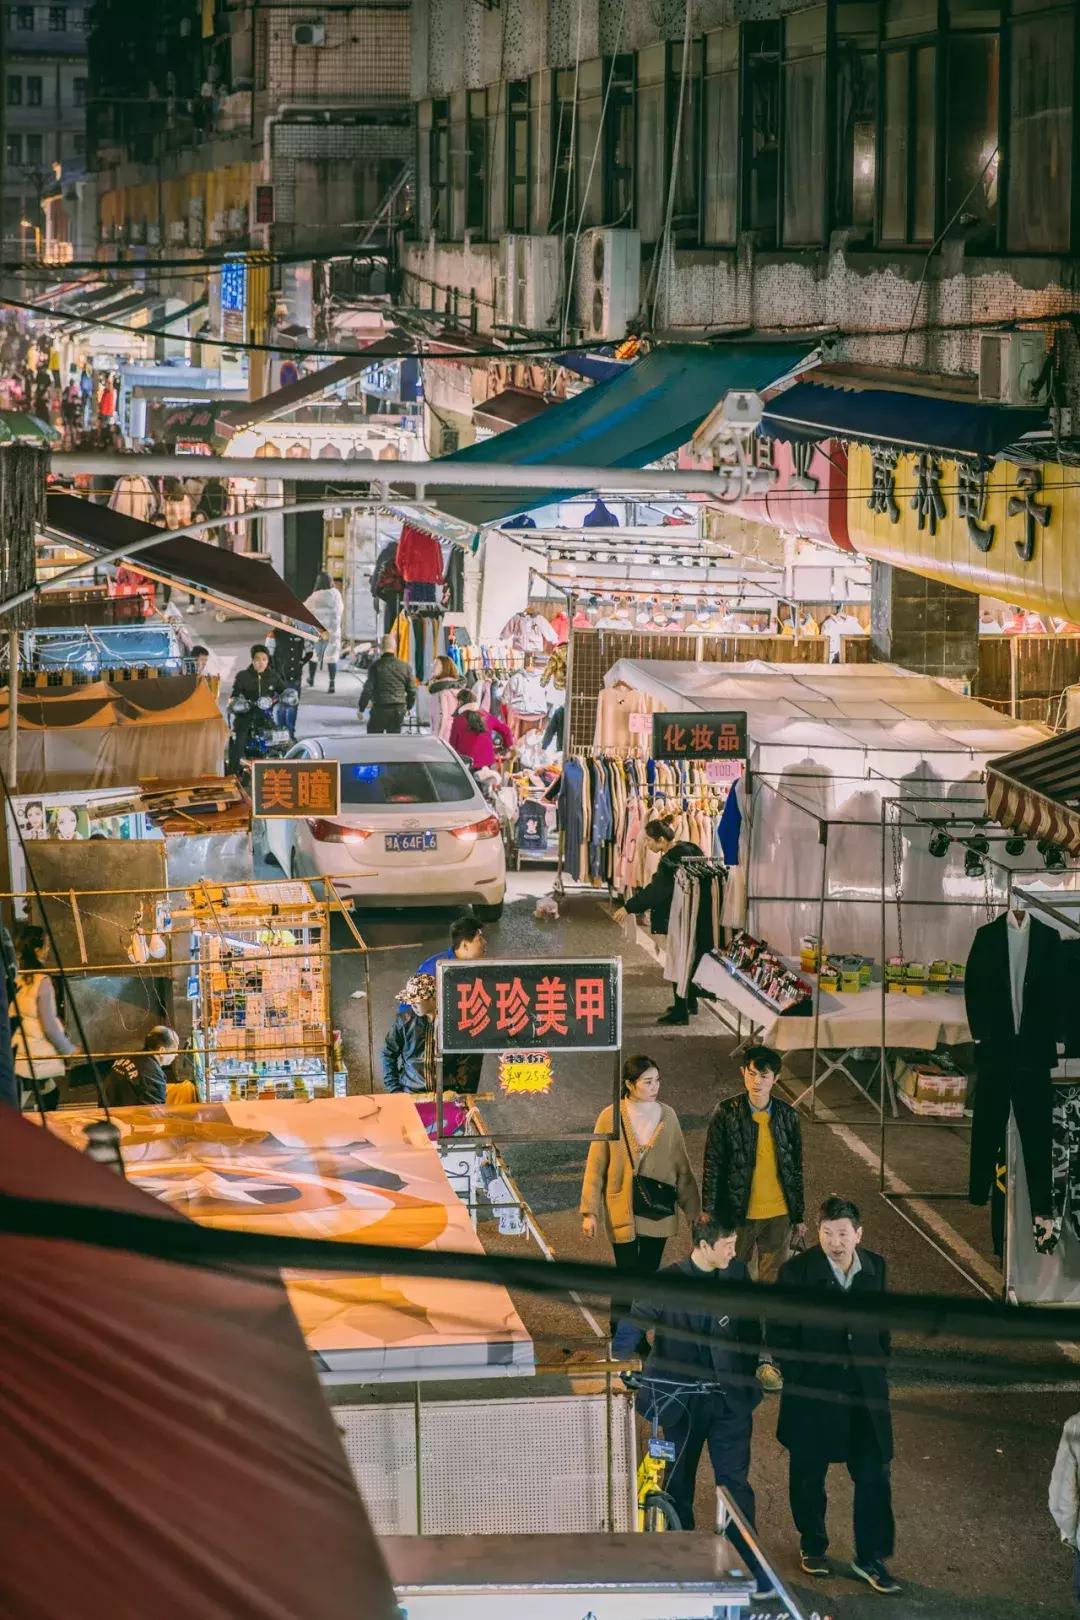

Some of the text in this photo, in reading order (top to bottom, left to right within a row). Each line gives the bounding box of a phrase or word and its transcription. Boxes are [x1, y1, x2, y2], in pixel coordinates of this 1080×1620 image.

[663, 723, 740, 752] 化妆品
[261, 768, 333, 809] 美瞳
[456, 975, 605, 1038] 珍珍美甲
